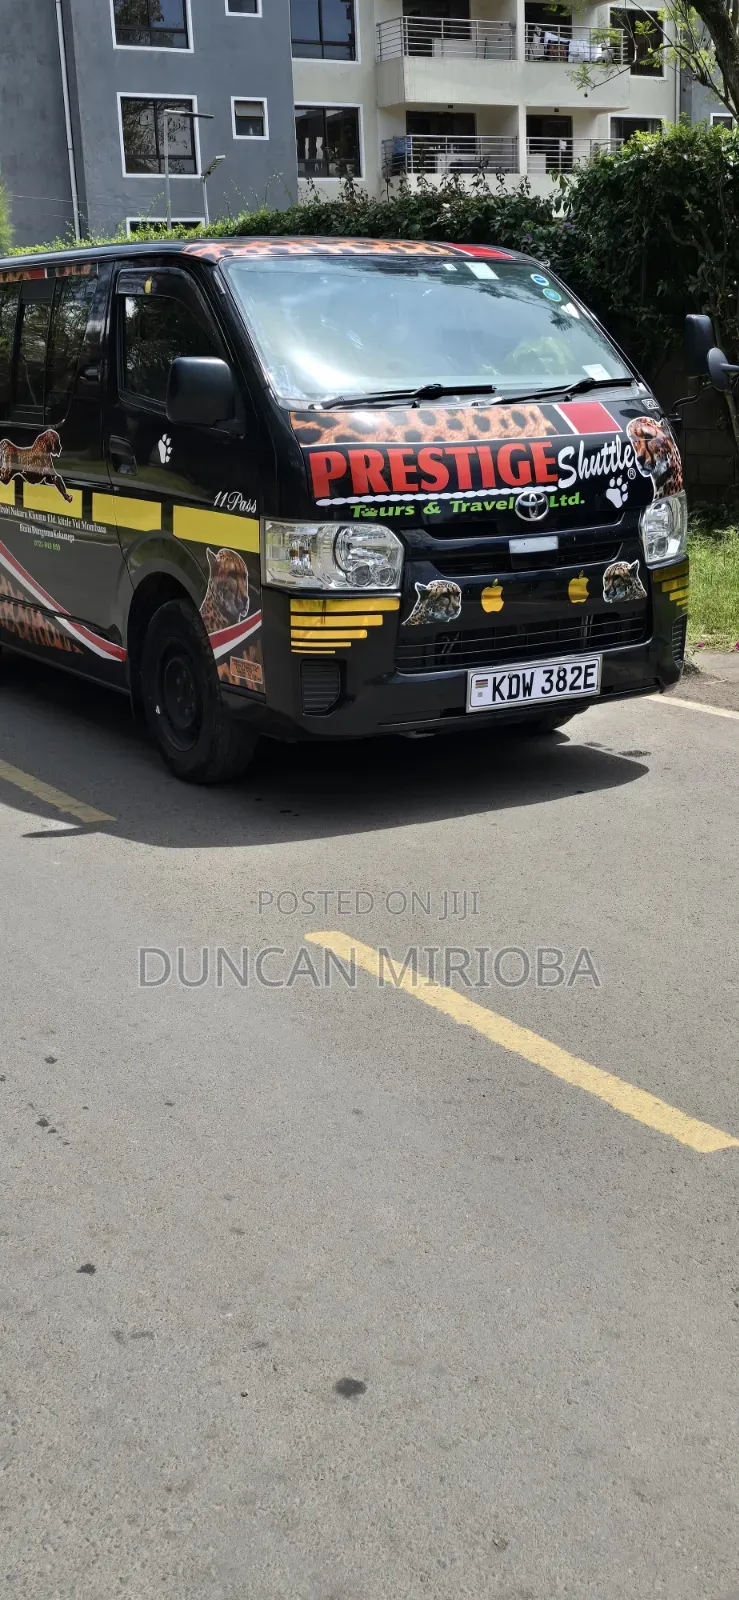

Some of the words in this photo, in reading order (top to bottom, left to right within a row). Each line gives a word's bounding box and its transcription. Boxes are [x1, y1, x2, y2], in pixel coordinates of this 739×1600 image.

[309, 441, 558, 498] PRESTIGE
[558, 434, 634, 489] Shuttle
[423, 501, 441, 515] &
[549, 491, 585, 508] Ltd.
[492, 671, 534, 702] KDW
[541, 663, 597, 695] 382E
